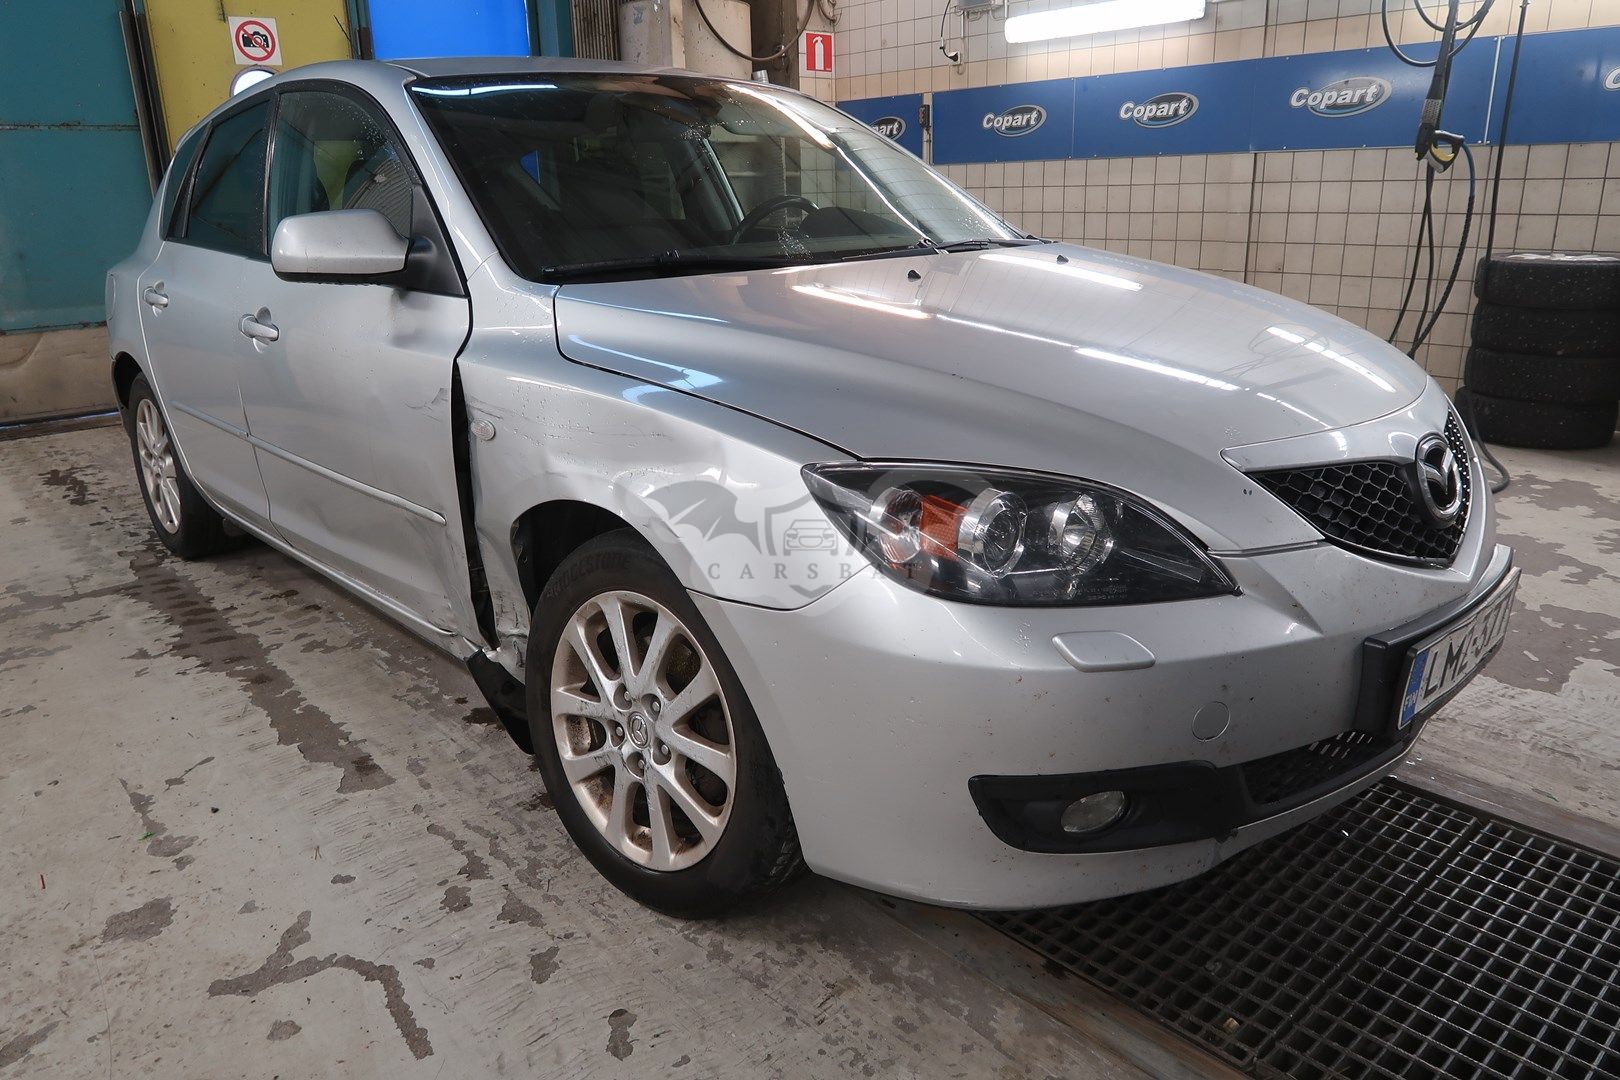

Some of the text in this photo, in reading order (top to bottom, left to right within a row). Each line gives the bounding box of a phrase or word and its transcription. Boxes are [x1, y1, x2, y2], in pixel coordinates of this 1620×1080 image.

[1290, 84, 1378, 109] Copart
[982, 110, 1039, 131] Copart
[1120, 98, 1188, 121] Copart
